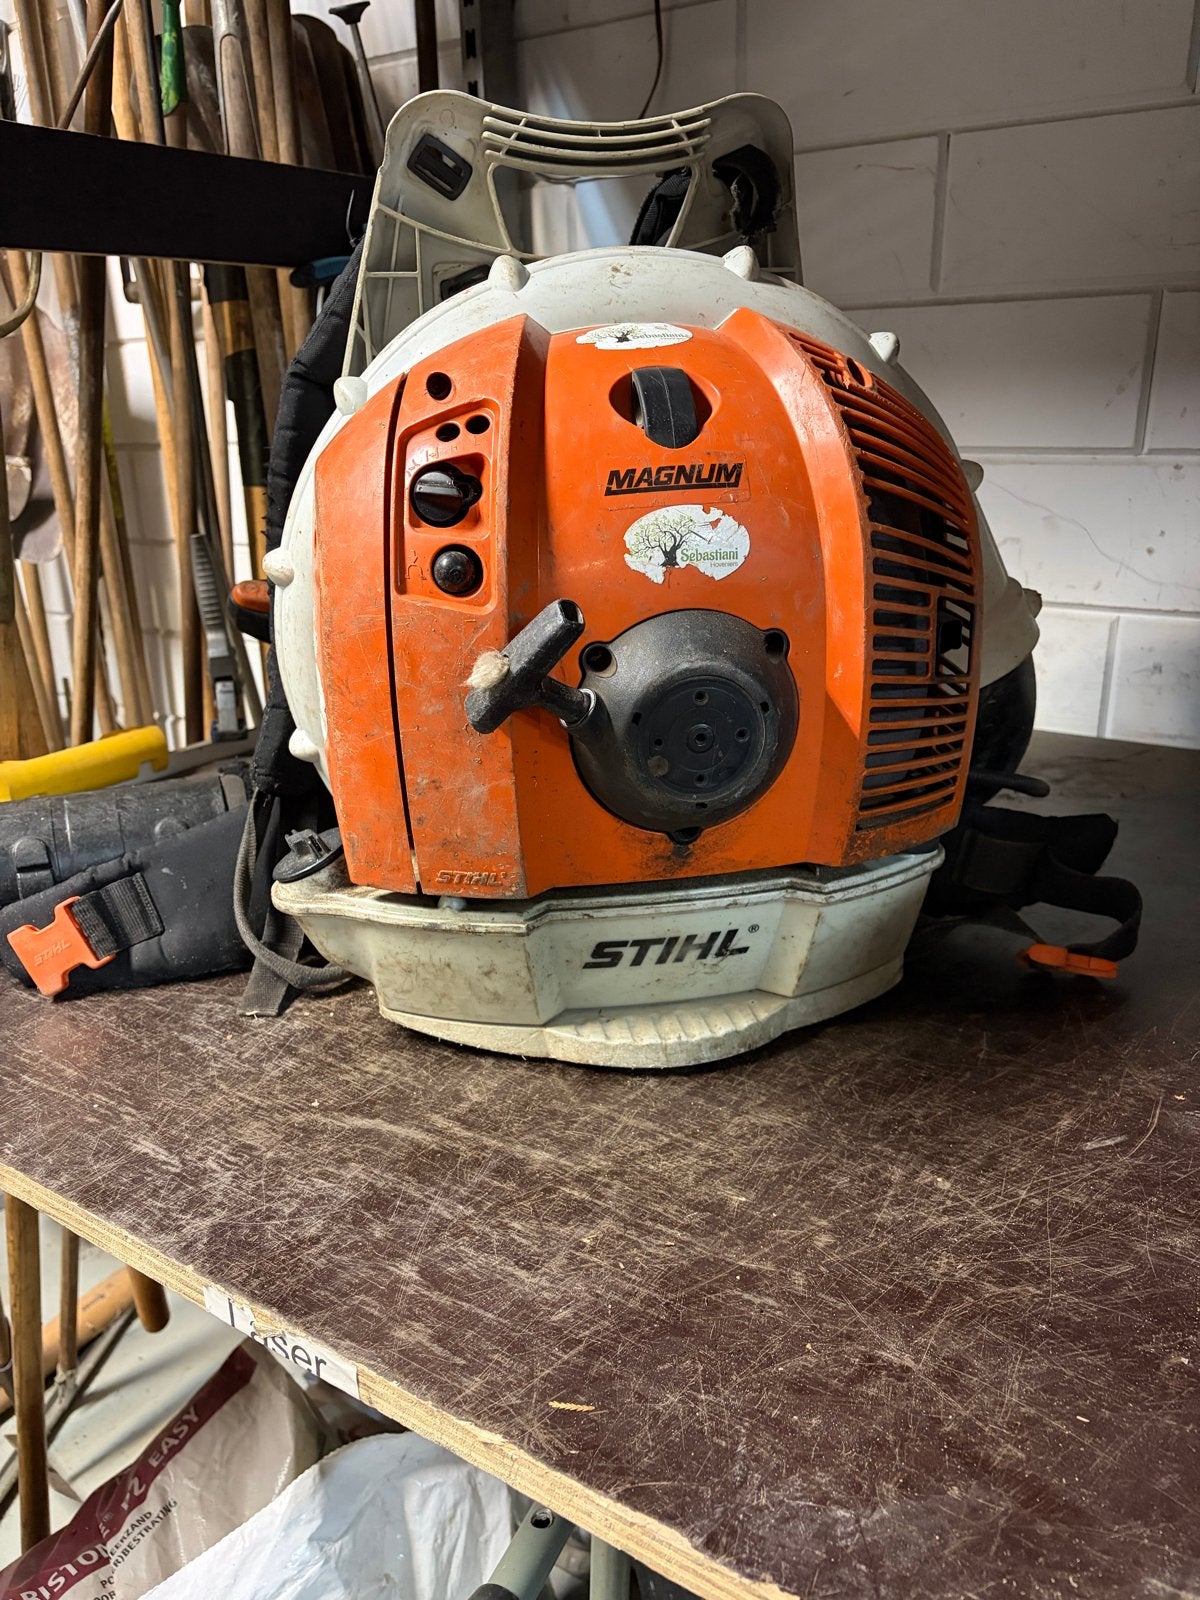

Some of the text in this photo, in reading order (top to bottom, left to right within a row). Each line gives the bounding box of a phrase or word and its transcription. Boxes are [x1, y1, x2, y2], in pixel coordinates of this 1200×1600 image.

[605, 463, 743, 493] MAGNUM
[680, 548, 739, 562] Sebastiani
[435, 869, 503, 885] STIHL
[33, 940, 72, 966] STIHL
[148, 1405, 203, 1468] EASY
